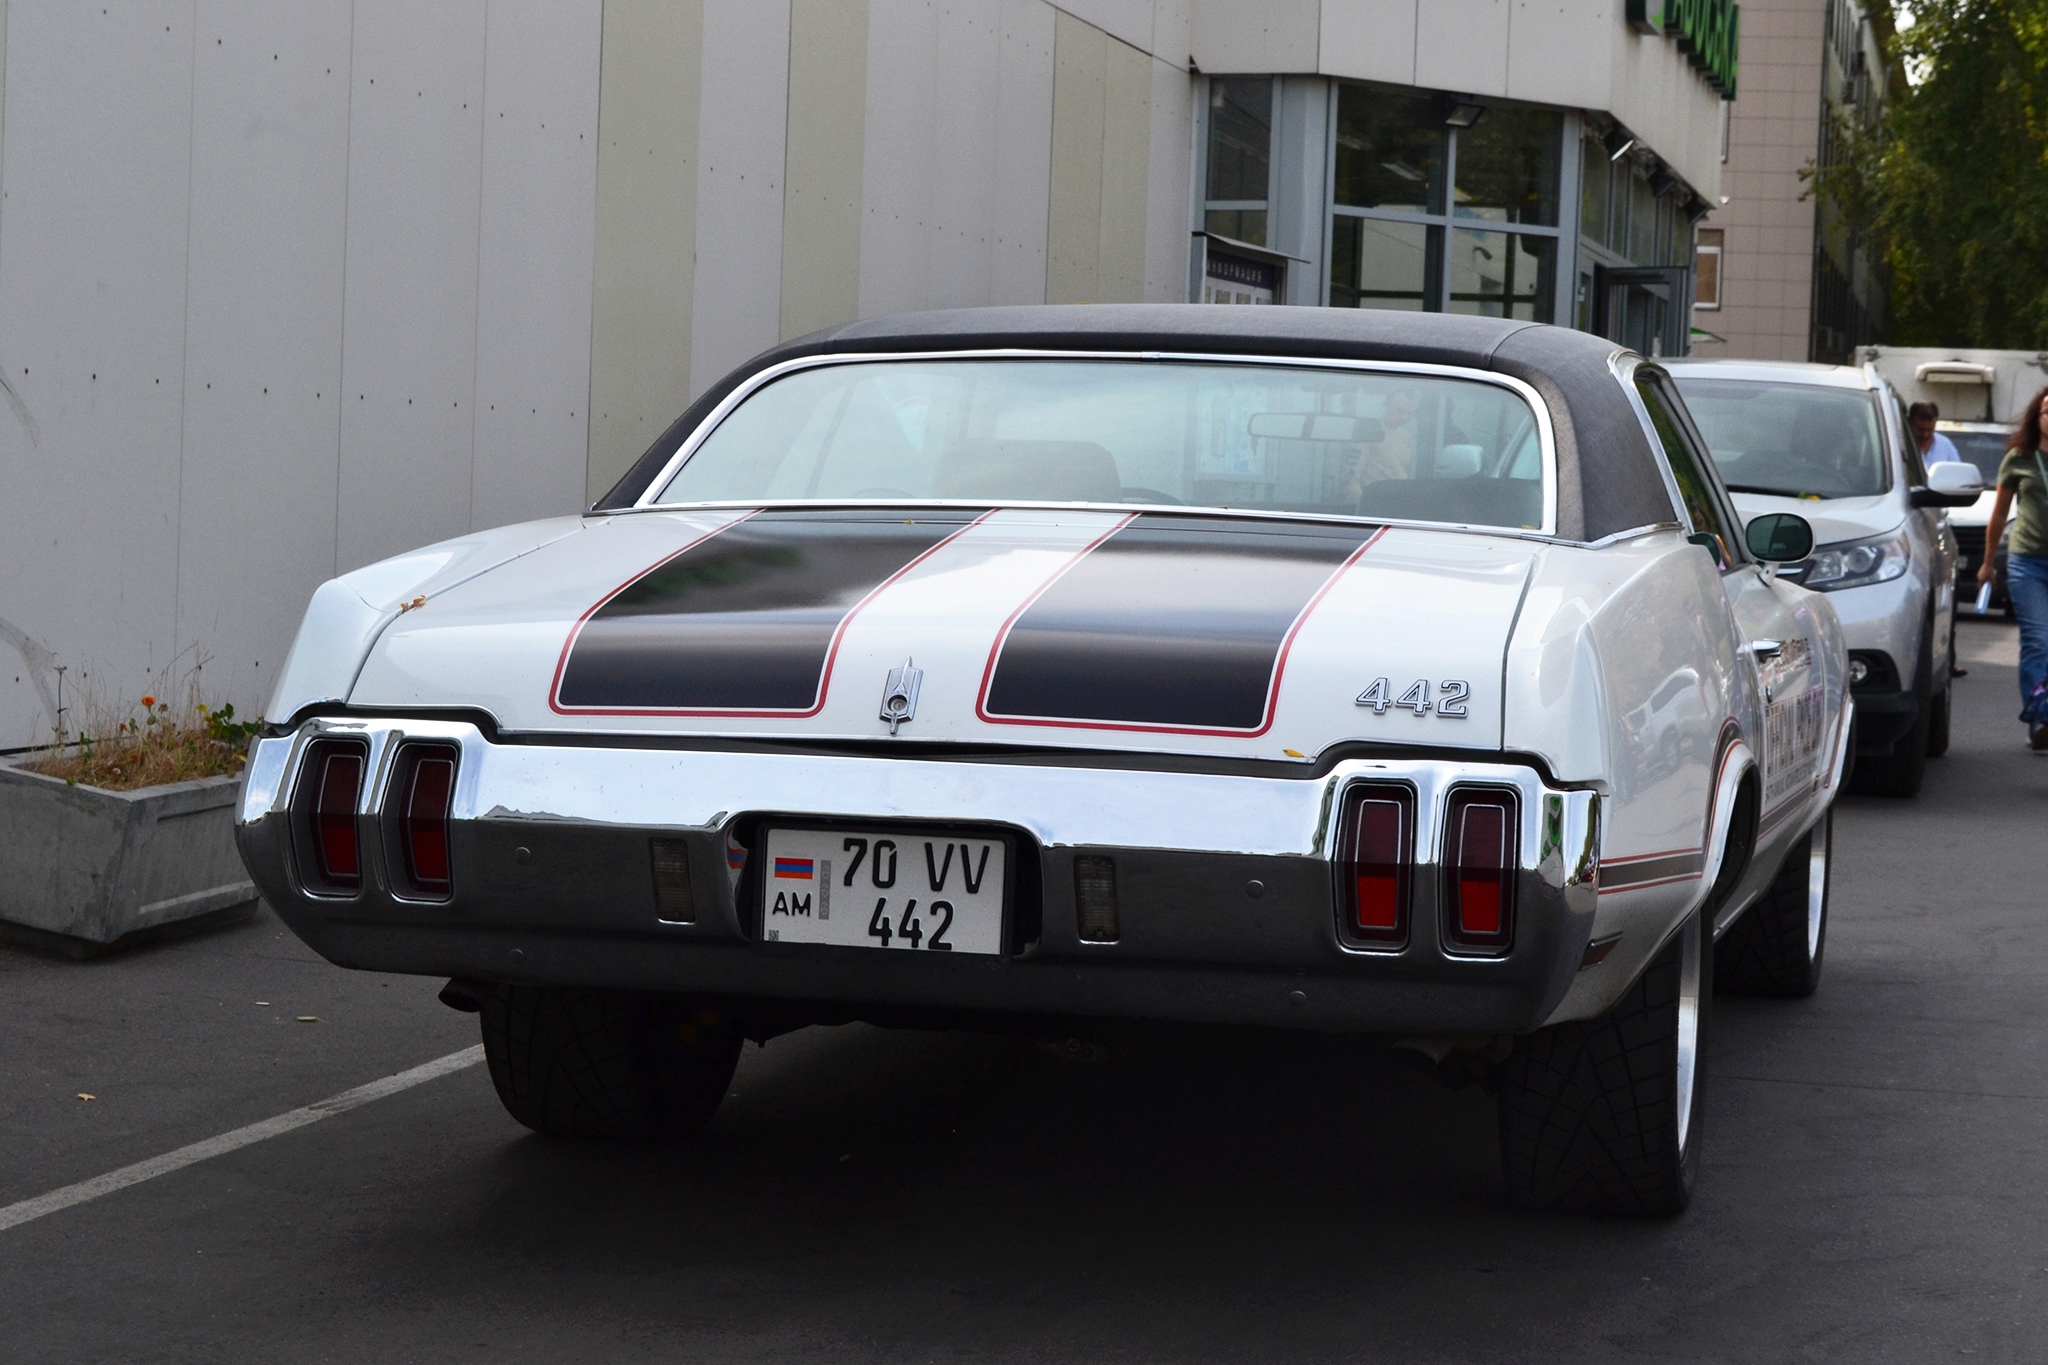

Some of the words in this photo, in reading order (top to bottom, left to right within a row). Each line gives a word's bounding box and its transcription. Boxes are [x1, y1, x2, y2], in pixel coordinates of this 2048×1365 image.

[1354, 676, 1471, 719] 442
[843, 837, 898, 888] 70
[924, 842, 990, 894] VV
[772, 891, 812, 917] AM
[868, 897, 955, 951] 442
